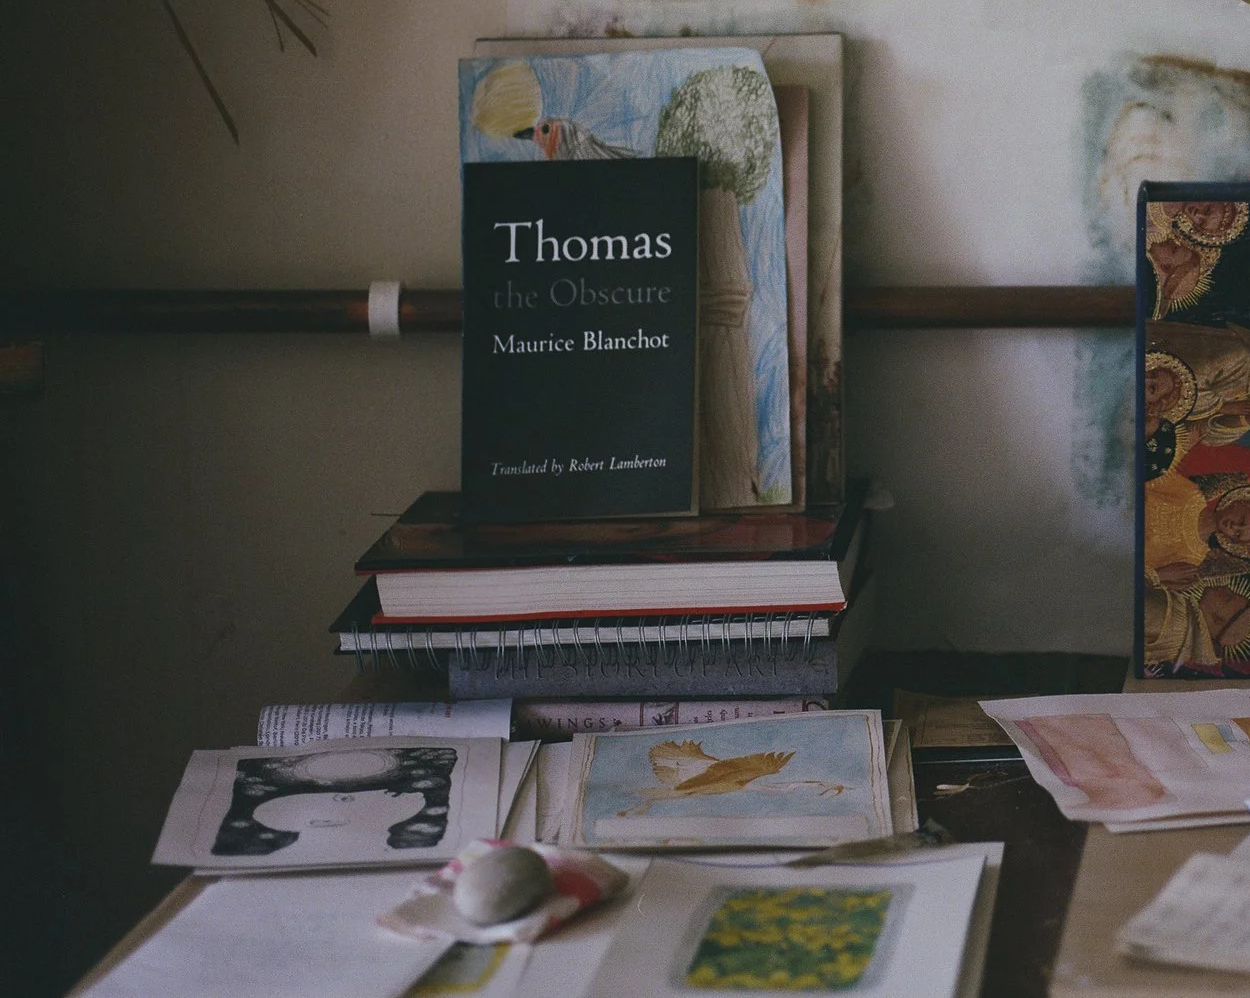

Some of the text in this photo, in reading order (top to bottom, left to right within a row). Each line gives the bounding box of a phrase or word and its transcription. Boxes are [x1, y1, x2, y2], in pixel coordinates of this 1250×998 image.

[493, 219, 672, 263] Thomas
[493, 275, 672, 309] the Obscure
[492, 329, 670, 354] Maurice Blanchot
[491, 455, 667, 476] Translated by Robert Lamberton
[722, 651, 783, 678] ART
